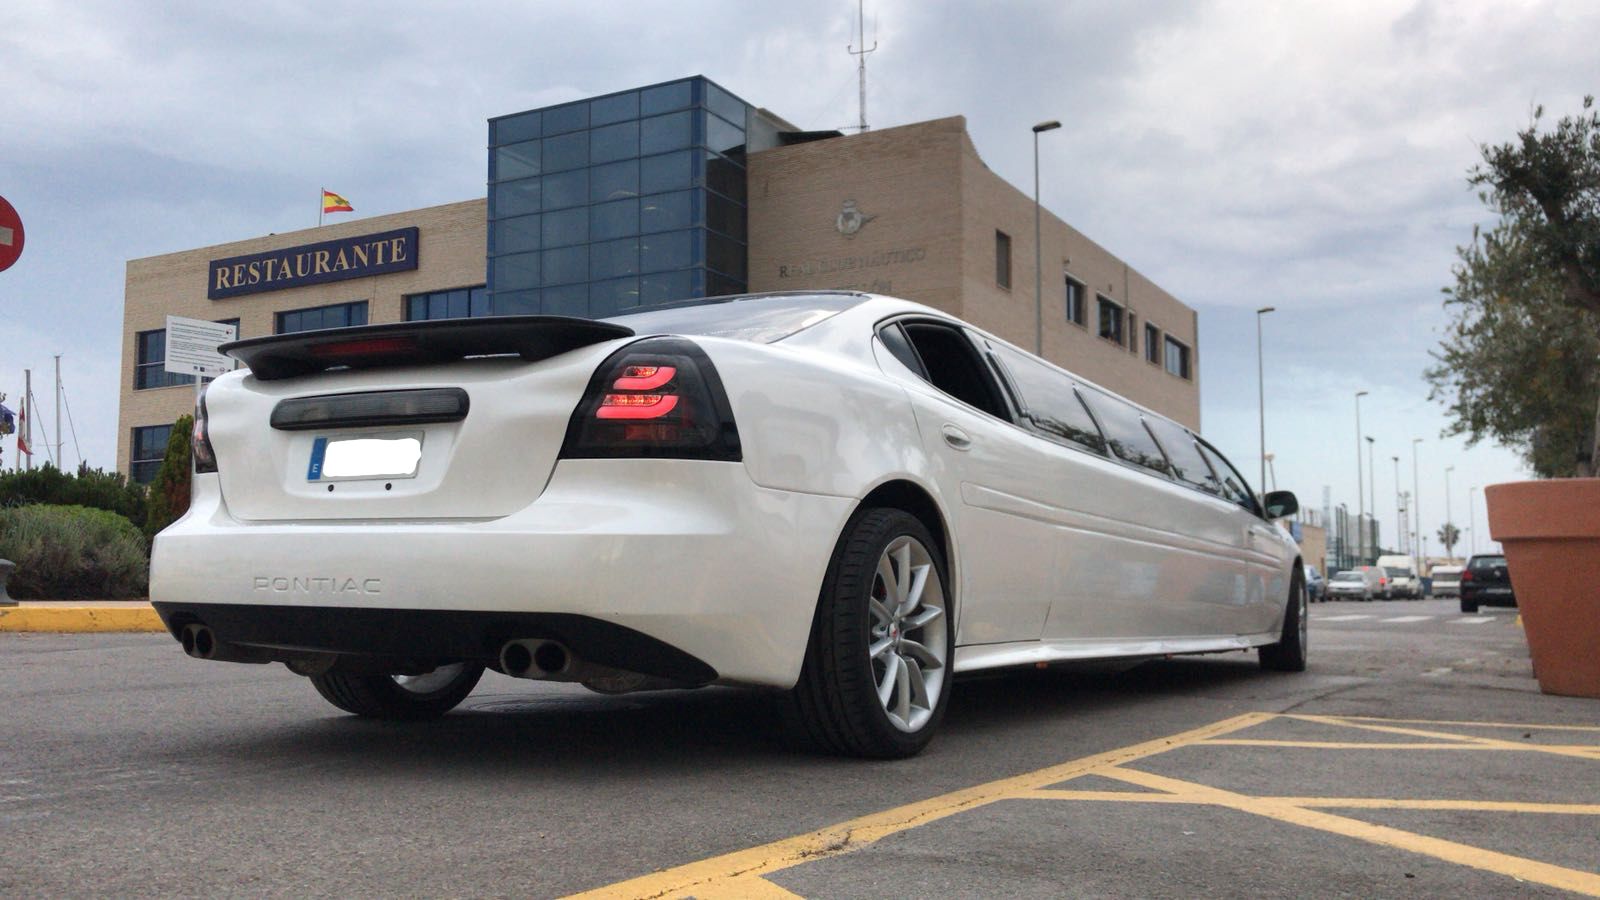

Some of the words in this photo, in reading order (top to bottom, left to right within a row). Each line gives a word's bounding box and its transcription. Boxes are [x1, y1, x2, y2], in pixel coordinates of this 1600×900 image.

[215, 237, 407, 290] RESTAURANTE
[312, 463, 319, 473] E
[253, 576, 382, 595] PONTIAC
